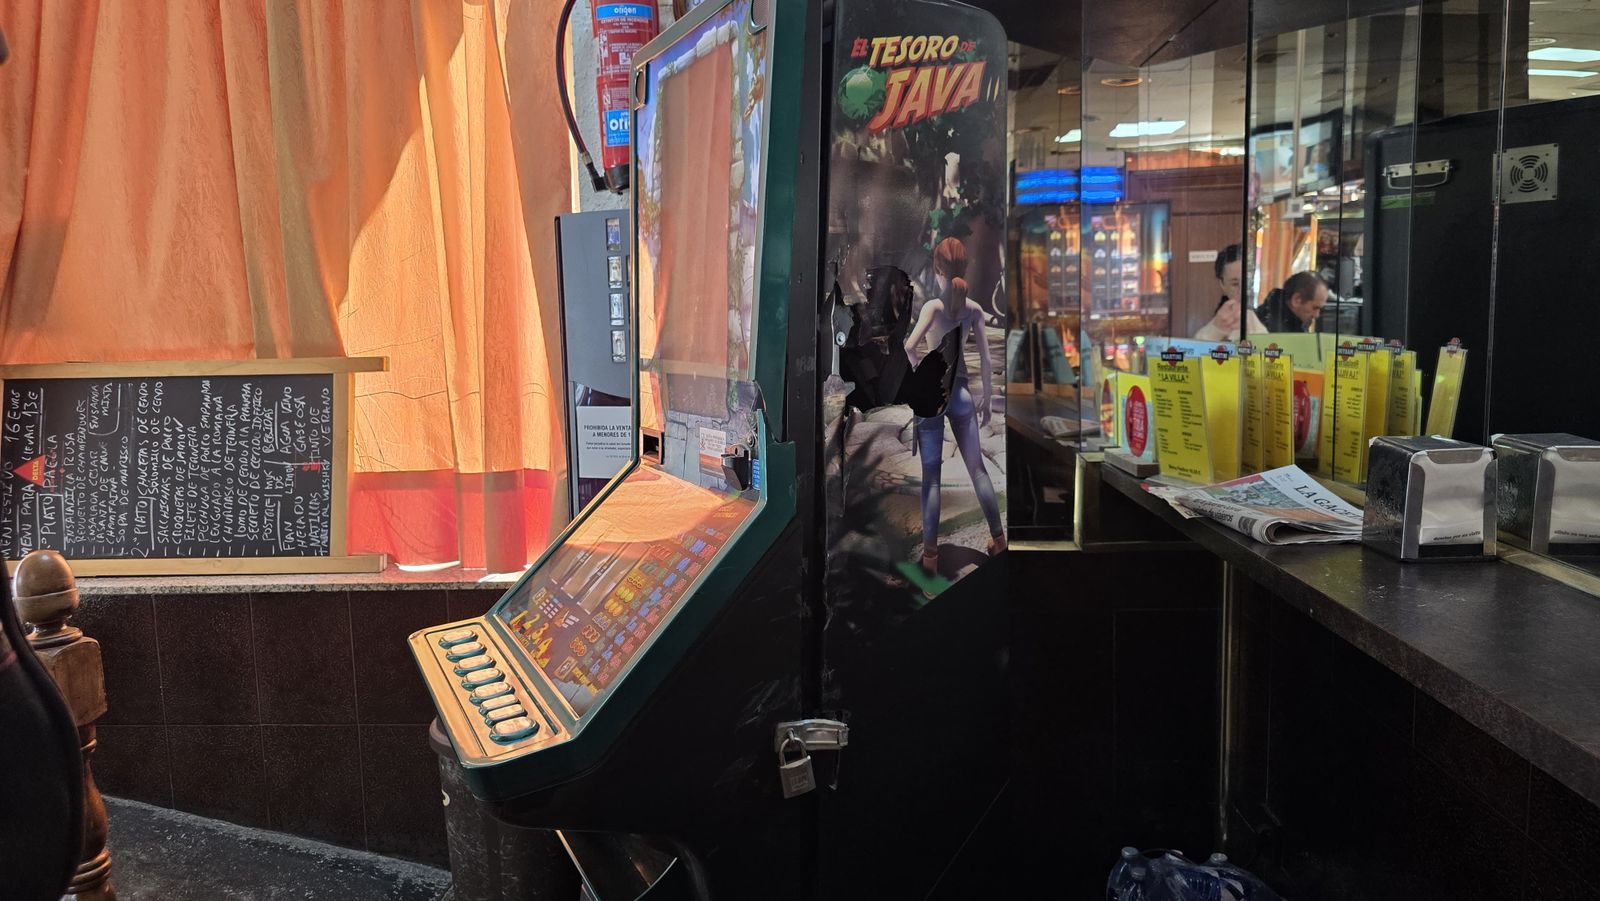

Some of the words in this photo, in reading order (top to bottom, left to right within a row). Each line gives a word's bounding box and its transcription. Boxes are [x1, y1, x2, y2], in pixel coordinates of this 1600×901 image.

[851, 37, 868, 58] EL
[869, 35, 959, 68] TESORO
[959, 41, 977, 53] DE
[866, 61, 987, 134] JAVA
[137, 416, 148, 433] DE
[151, 418, 160, 434] DE
[213, 396, 223, 444] ROMANA
[240, 426, 250, 437] LA
[262, 408, 275, 453] BEBIDAS
[294, 395, 307, 452] GASEOSA
[310, 407, 320, 424] DE
[321, 387, 330, 446] VERANO
[4, 424, 20, 442] 16
[162, 415, 173, 450] POLLO
[173, 417, 186, 464] JAMON
[200, 434, 211, 462] POLLO
[280, 421, 292, 454] AGUA
[64, 432, 75, 466] RUSA
[120, 435, 129, 486] MARISCO
[160, 455, 174, 470] DE
[188, 426, 199, 479] TERNERA
[212, 449, 221, 463] LA
[224, 456, 233, 471] DE
[76, 476, 86, 489] DE
[100, 476, 108, 491] DE
[137, 439, 149, 496] CHULETAS
[175, 466, 185, 481] DE
[200, 466, 209, 480] DE
[211, 467, 221, 476] A
[250, 472, 260, 489] DE
[273, 475, 283, 489] DE
[21, 484, 36, 515] PARA
[119, 489, 129, 505] DE
[187, 481, 198, 497] DE
[237, 488, 248, 505] DE
[1294, 485, 1316, 498] LA
[1314, 498, 1364, 520] GACET
[40, 496, 56, 534] PLATO
[76, 492, 86, 542] REVUELTO
[88, 491, 97, 541] ENSALADA
[117, 512, 128, 543] SOPA
[134, 502, 148, 534] PLATO
[173, 486, 184, 544] CROQUETAS
[184, 502, 196, 541] FILETE
[198, 486, 209, 541] PECHUGA
[210, 482, 221, 543] LENGUADO
[234, 510, 247, 538] LOMO
[248, 494, 259, 540] SECRETO
[294, 496, 307, 548] HELADO
[309, 492, 321, 547] NATILLAS
[283, 520, 295, 550] FLAN
